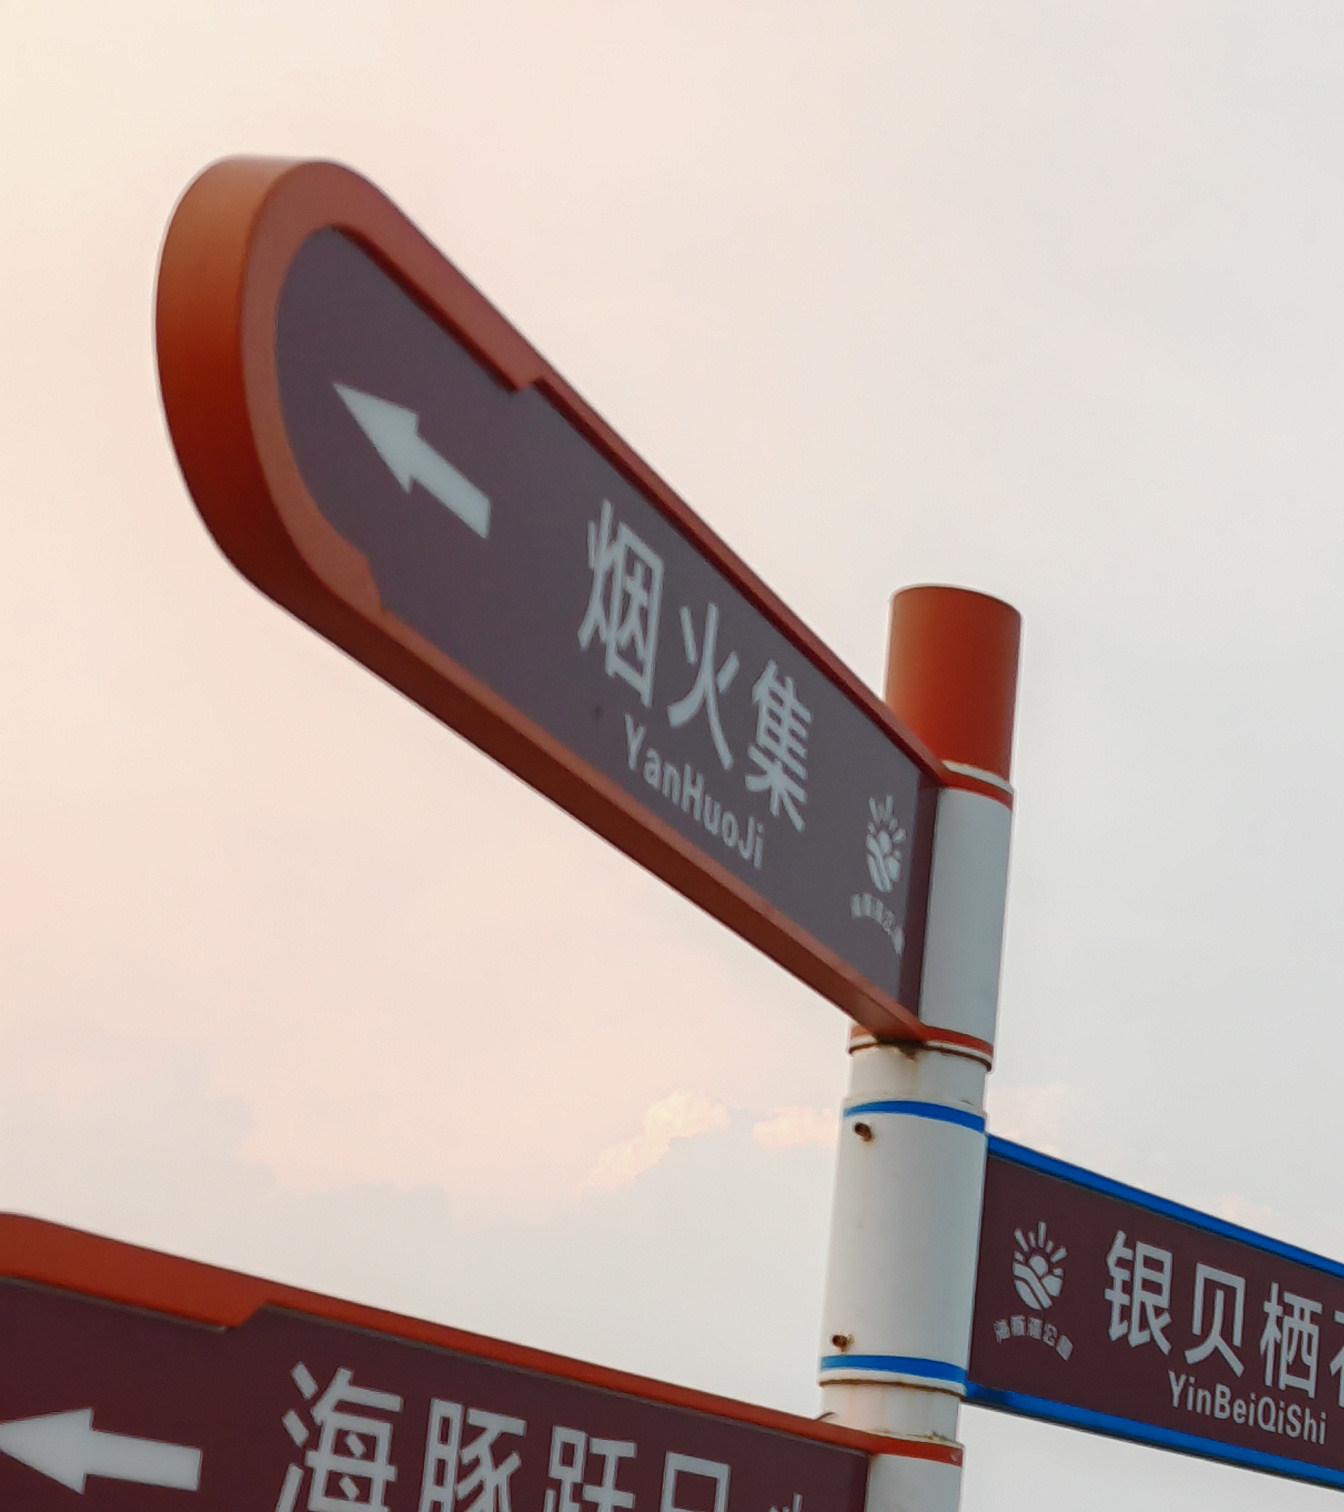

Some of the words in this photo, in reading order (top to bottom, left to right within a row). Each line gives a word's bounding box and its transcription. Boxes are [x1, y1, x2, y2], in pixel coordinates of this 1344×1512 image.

[578, 498, 812, 832] 烟火集
[624, 712, 765, 870] YanHuoJi
[1167, 1369, 1327, 1445] YinBeiQiShi
